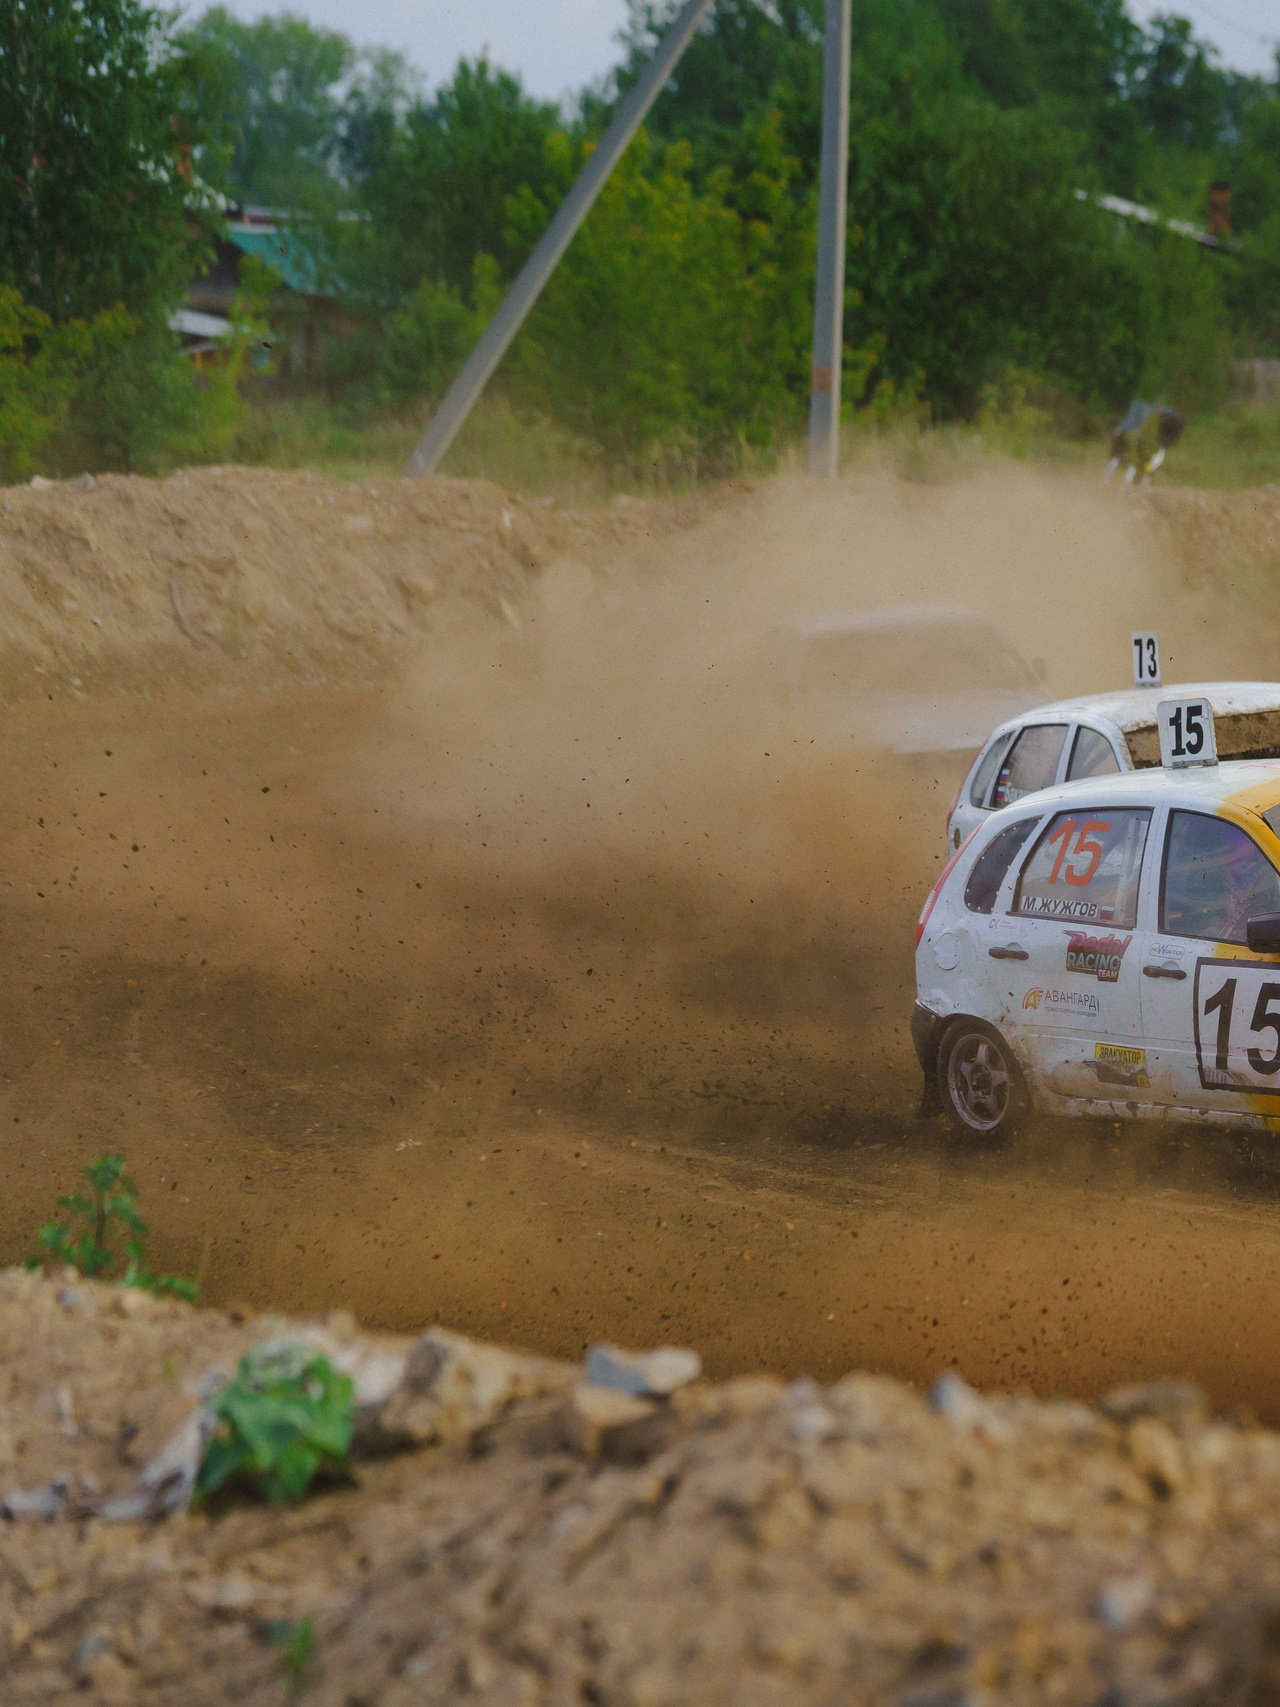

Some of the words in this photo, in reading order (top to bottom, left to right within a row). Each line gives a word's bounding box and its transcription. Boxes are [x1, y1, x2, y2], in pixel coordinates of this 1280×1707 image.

[1169, 705, 1204, 756] 15
[1048, 820, 1112, 886] 15
[1023, 896, 1098, 917] М.ЖУЖГОВ
[1067, 951, 1121, 971] RACING
[1098, 969, 1118, 979] TEAM
[1044, 989, 1097, 1011] АВАНГАРД
